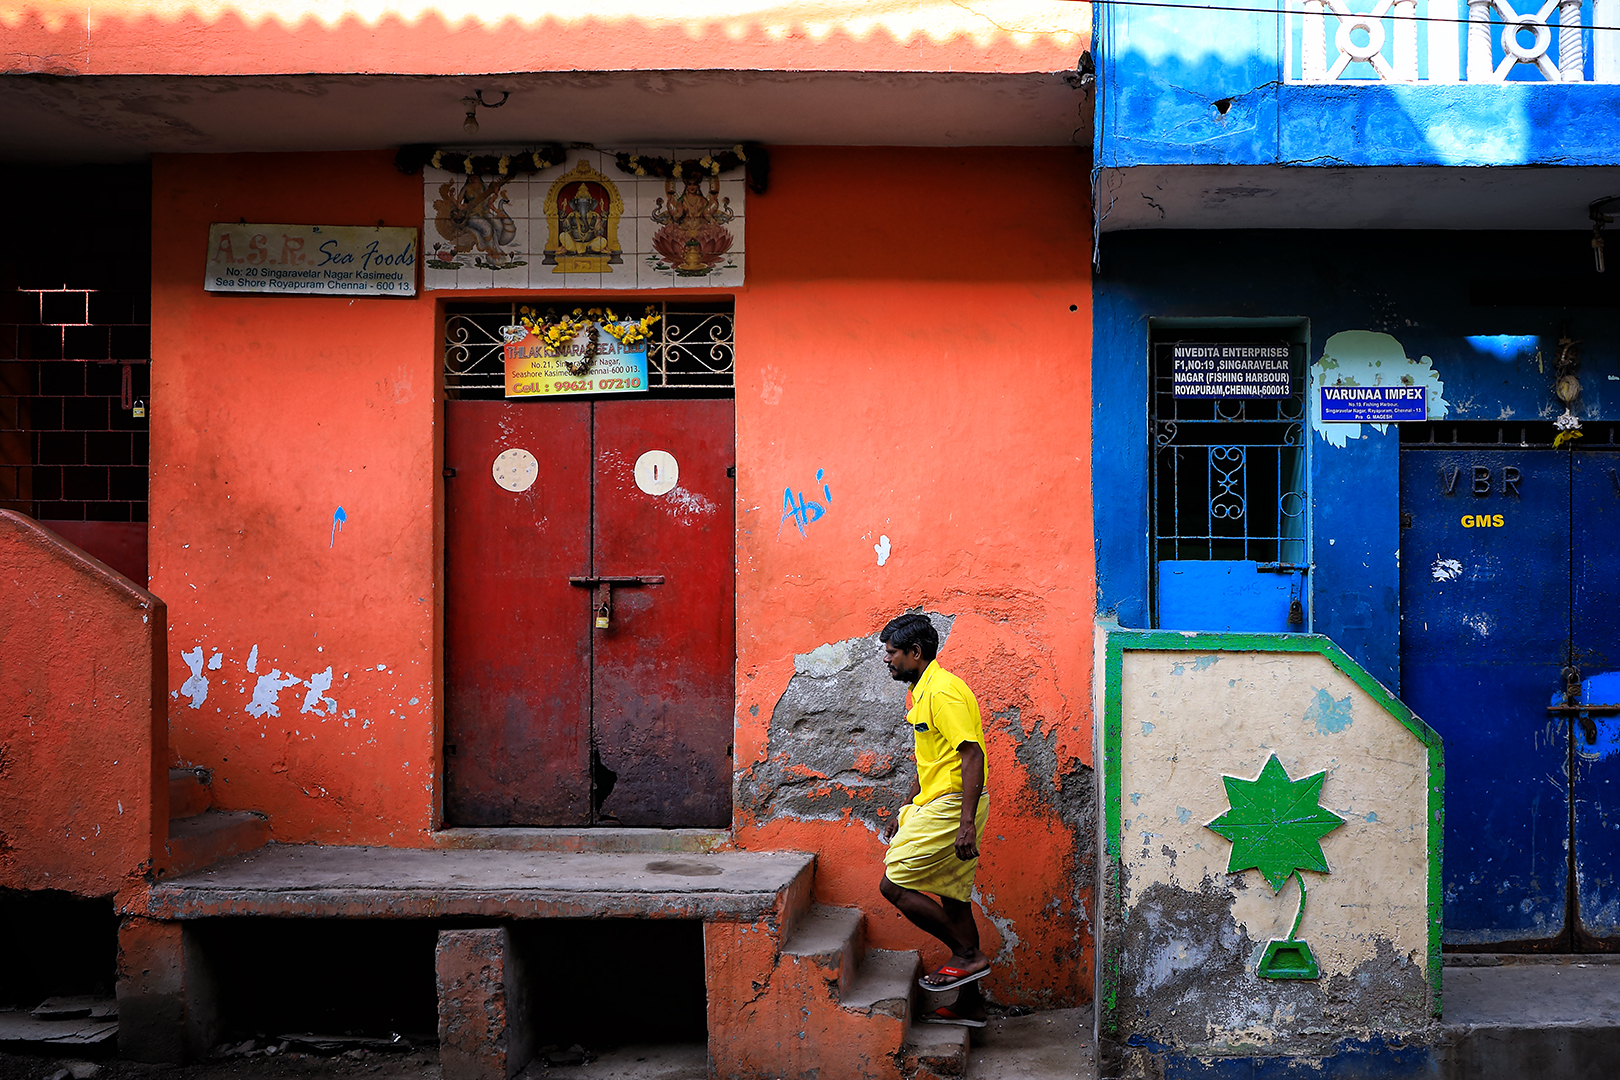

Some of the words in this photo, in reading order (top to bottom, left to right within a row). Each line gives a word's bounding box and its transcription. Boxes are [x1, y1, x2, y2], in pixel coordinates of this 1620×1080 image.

[317, 239, 354, 266] Sea
[361, 240, 416, 270] Foods
[226, 267, 244, 277] No:
[246, 268, 258, 277] 20
[262, 268, 321, 279] Singaravelar
[323, 269, 354, 281] Nagar
[356, 270, 403, 280] Kasimedu
[215, 278, 235, 286] Sea
[238, 278, 266, 287] Shore
[269, 278, 325, 290] Royapuram
[327, 280, 368, 290] Chennai
[376, 281, 395, 290] 600
[1174, 347, 1220, 358] NIVEDITA
[1222, 347, 1289, 358] ENTERPRISES
[512, 370, 543, 378] Seashore
[1174, 372, 1205, 383] NAGAR
[1206, 372, 1244, 384] (FISHING
[1245, 372, 1290, 384] HARBOUR)
[512, 382, 540, 393] Cell
[554, 380, 593, 392] 99621
[599, 377, 641, 389] 07210
[1324, 388, 1382, 400] VARUNAA
[1385, 388, 1423, 400] IMPEX
[1461, 514, 1505, 528] GMS
